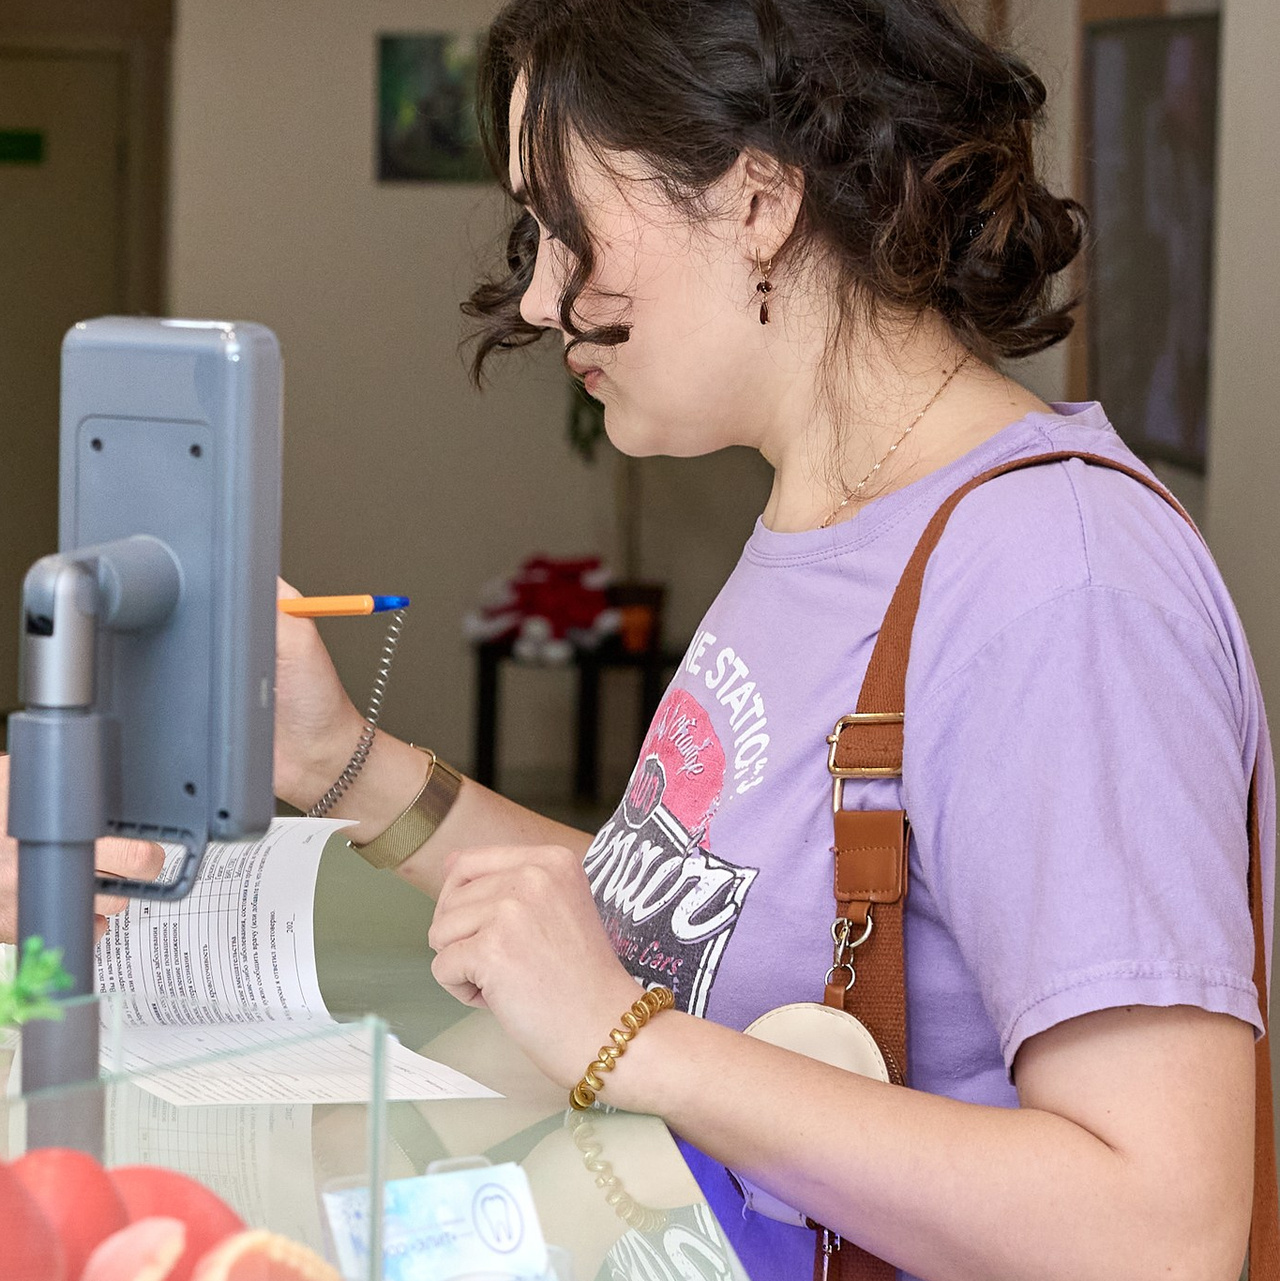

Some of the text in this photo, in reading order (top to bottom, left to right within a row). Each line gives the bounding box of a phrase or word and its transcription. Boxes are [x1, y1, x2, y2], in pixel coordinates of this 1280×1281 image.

[122, 904, 130, 930] береме
[240, 889, 248, 917] состояния
[114, 919, 122, 945] реакции
[153, 927, 161, 969] заболевания
[162, 922, 170, 966] повышенное
[172, 922, 180, 965] пониженное
[240, 919, 248, 962] заболевания,
[251, 930, 259, 949] врачу
[269, 910, 277, 950] достоверно.
[105, 937, 113, 974] настоящее
[115, 948, 126, 994] лергические
[124, 932, 133, 978] подозреваете
[184, 952, 192, 984] сознания
[203, 944, 217, 998] кровоточивость
[231, 936, 242, 989] вмешательства
[252, 952, 263, 986] сообщить
[270, 951, 279, 979] ответил
[638, 940, 684, 976] Cars
[242, 965, 255, 1001] какие-либо
